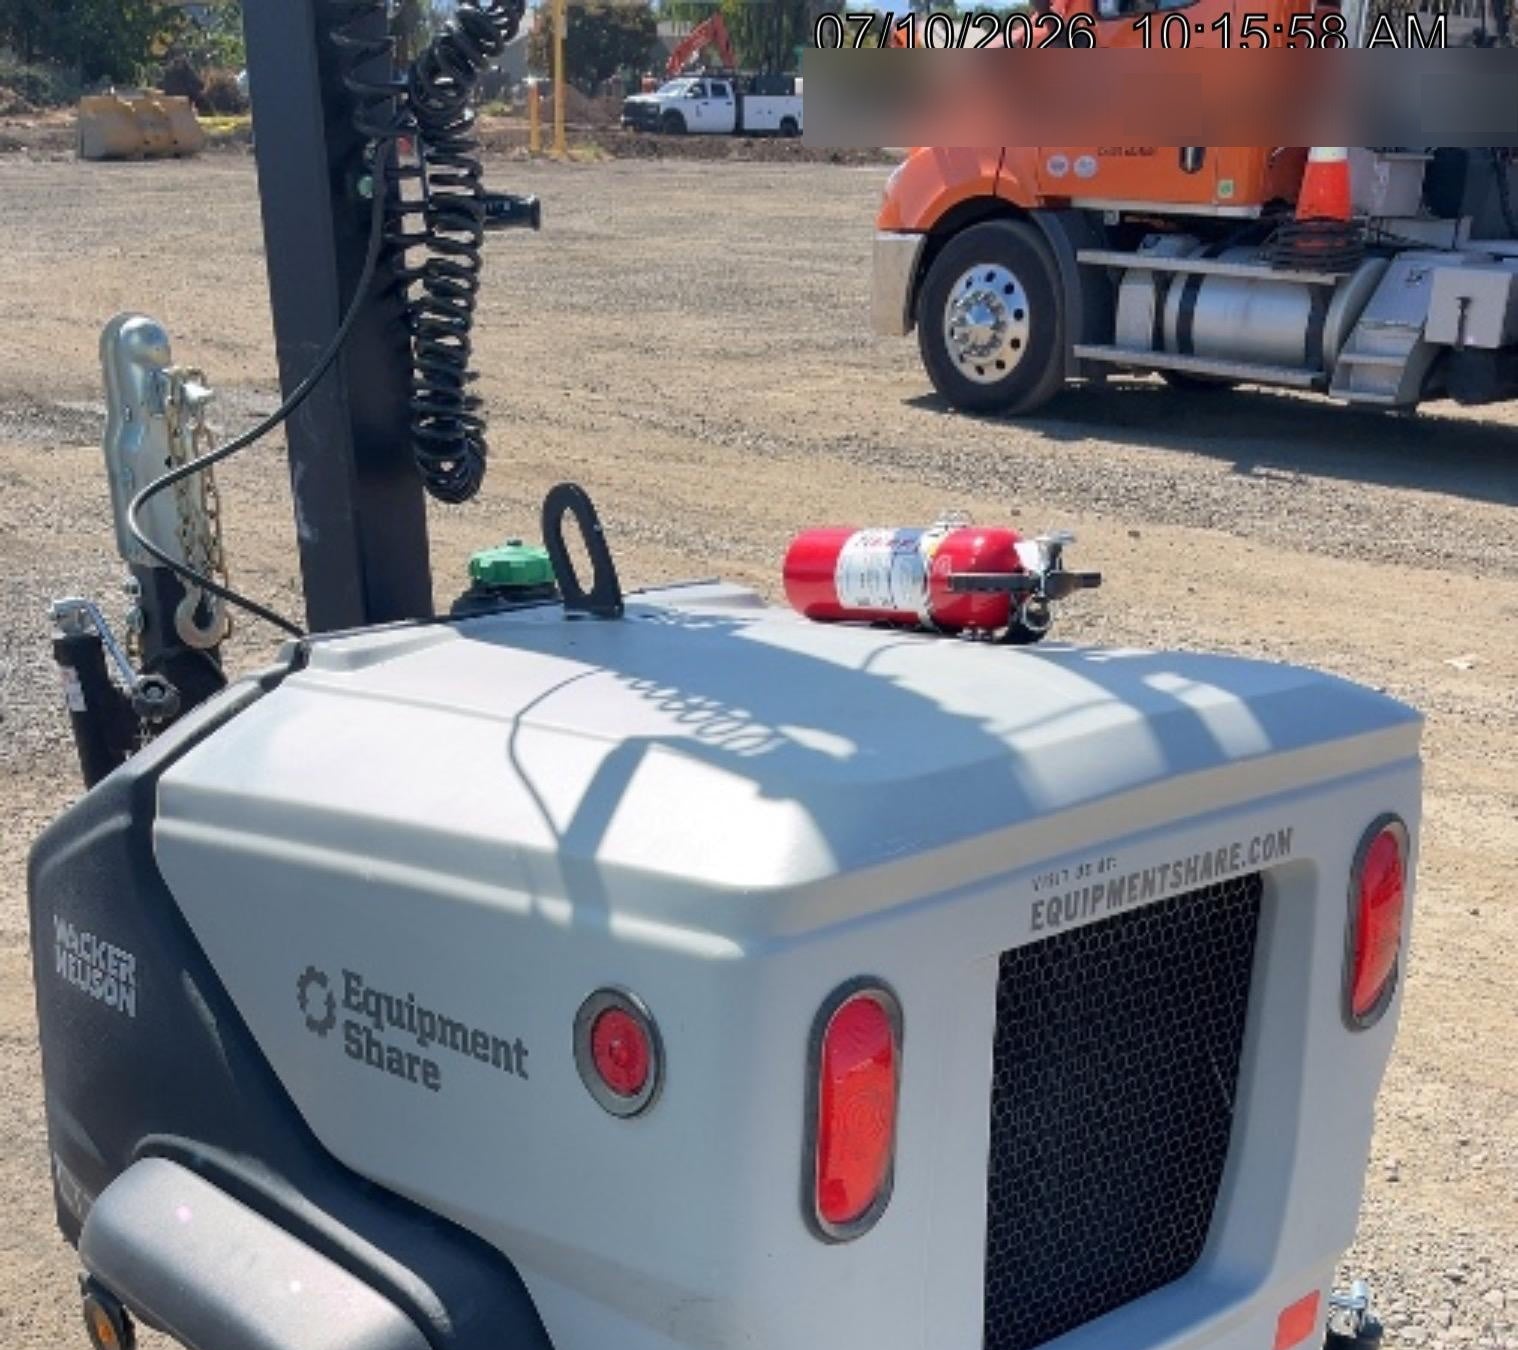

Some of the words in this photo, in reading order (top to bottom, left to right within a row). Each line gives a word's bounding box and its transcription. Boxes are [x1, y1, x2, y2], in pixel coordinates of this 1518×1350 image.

[1030, 827, 1294, 931] EQUIPMENTSHARE.COM
[52, 913, 136, 985] WACKER
[56, 944, 137, 1018] NEUSON
[341, 967, 529, 1080] Equipment
[342, 1018, 442, 1092] Share
